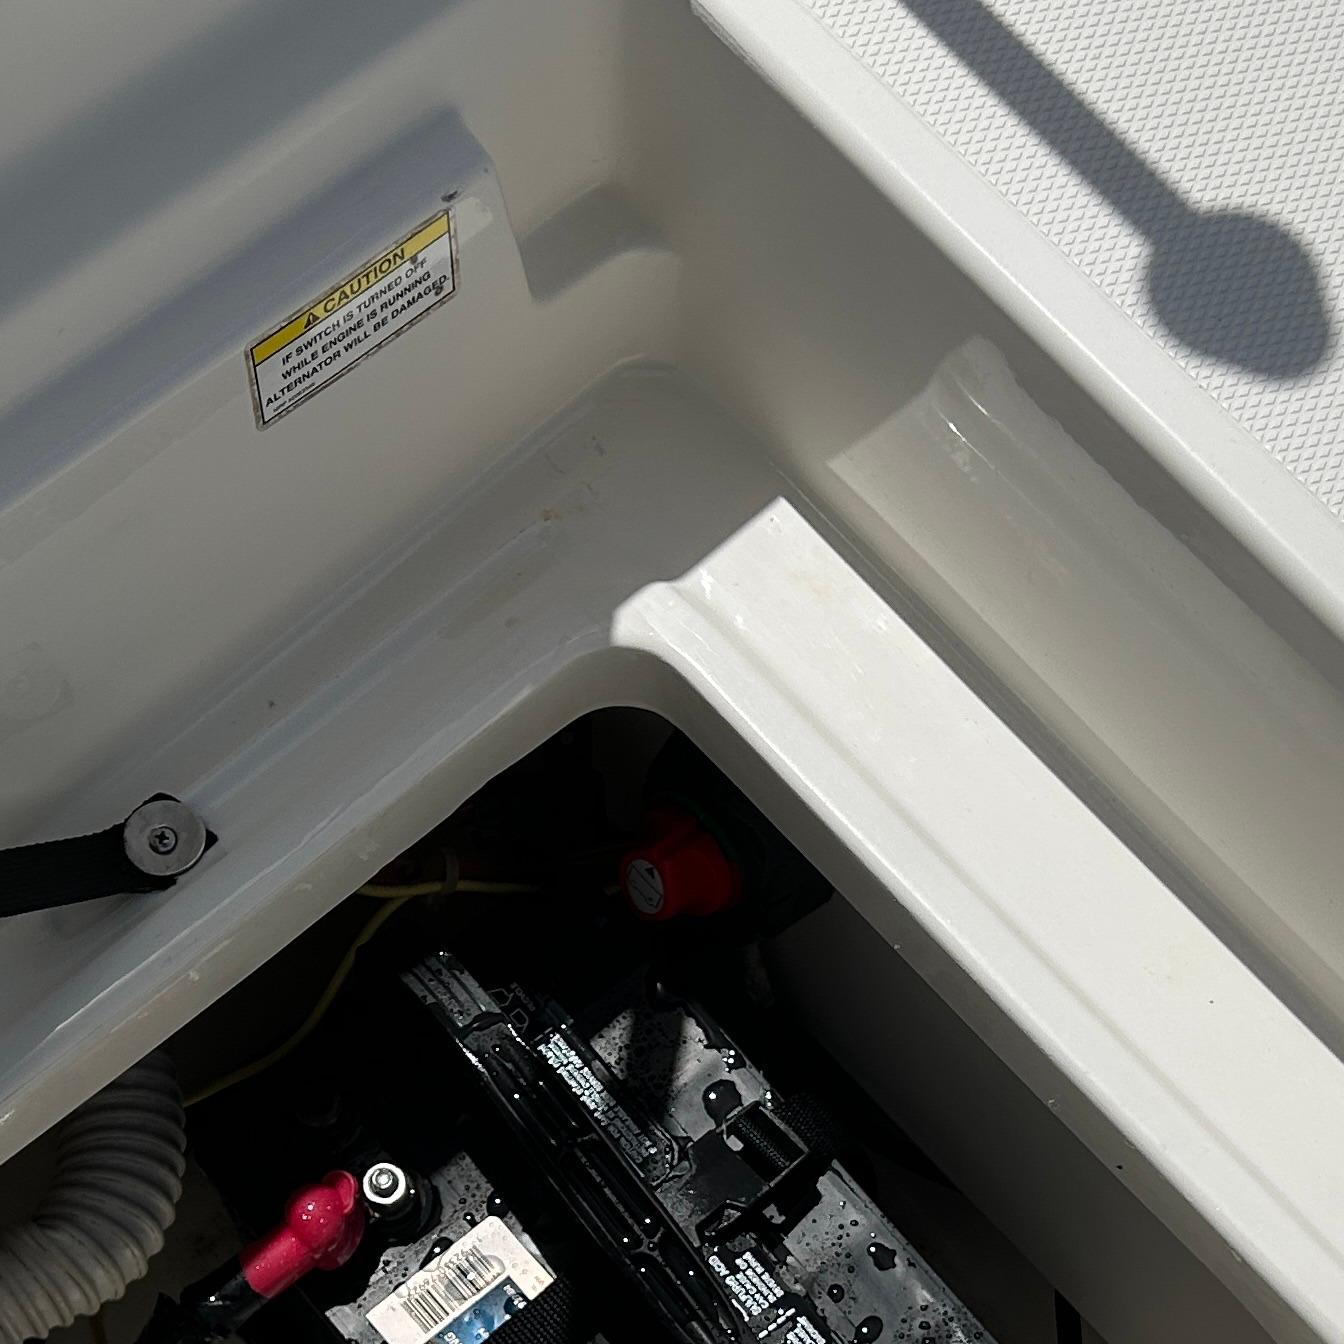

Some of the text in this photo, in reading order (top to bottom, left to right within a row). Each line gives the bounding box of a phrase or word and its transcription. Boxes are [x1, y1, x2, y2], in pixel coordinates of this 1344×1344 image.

[281, 271, 432, 381] WHILE ENGINE IS RUNNING
[282, 257, 427, 366] IF SWITCH IS TURNED OFF
[323, 248, 405, 314] CAUTION
[265, 350, 341, 408] ALTERNATOR
[343, 331, 371, 353] WILL
[374, 317, 389, 334] BE
[708, 1255, 728, 1276] ACID
